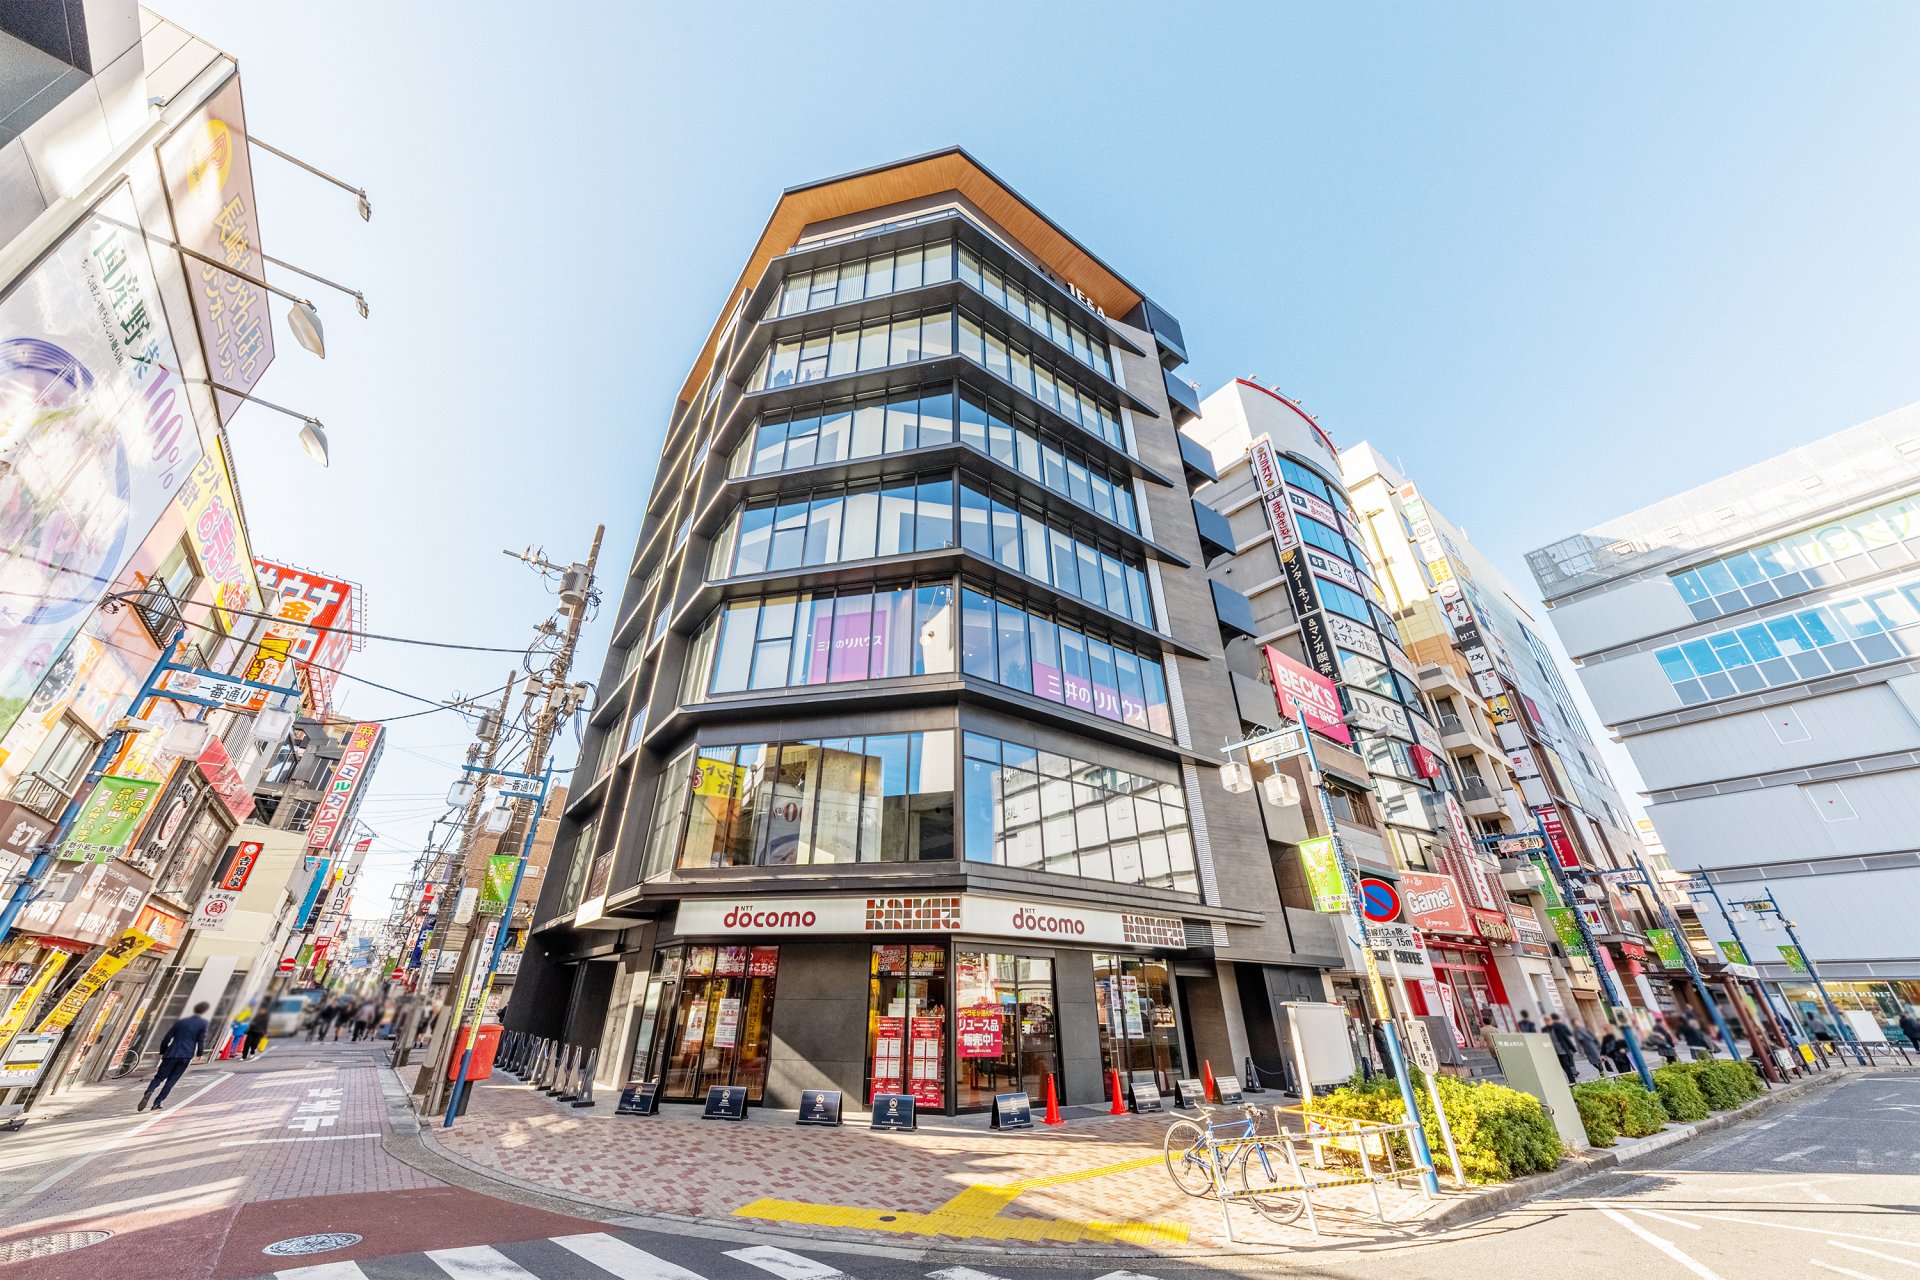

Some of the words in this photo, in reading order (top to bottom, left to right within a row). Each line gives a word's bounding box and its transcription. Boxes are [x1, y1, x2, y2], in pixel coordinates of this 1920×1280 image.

[214, 191, 265, 383] 長崎ちゃんぽん
[200, 264, 235, 381] リンガーハット
[1311, 556, 1324, 568] 6F
[1288, 555, 1313, 612] インターネット
[278, 600, 309, 622] 金
[816, 635, 882, 651] 三のリハウス
[1307, 618, 1332, 674] &マンガ喫茶
[199, 684, 251, 704] 一番通り
[1048, 674, 1146, 723] 三井のリハウス
[1276, 663, 1336, 711] BECK'S
[352, 725, 376, 750] 麻雀
[505, 780, 536, 793] 一番通り
[229, 855, 251, 888] 吉野家
[1406, 884, 1454, 914] Game!
[723, 905, 817, 928] docomo
[1012, 908, 1085, 935] docomo
[1396, 937, 1414, 948] 15m
[1819, 990, 1857, 998] ISTER
[1858, 990, 1891, 998] MINIT
[959, 1019, 999, 1031] リユース品
